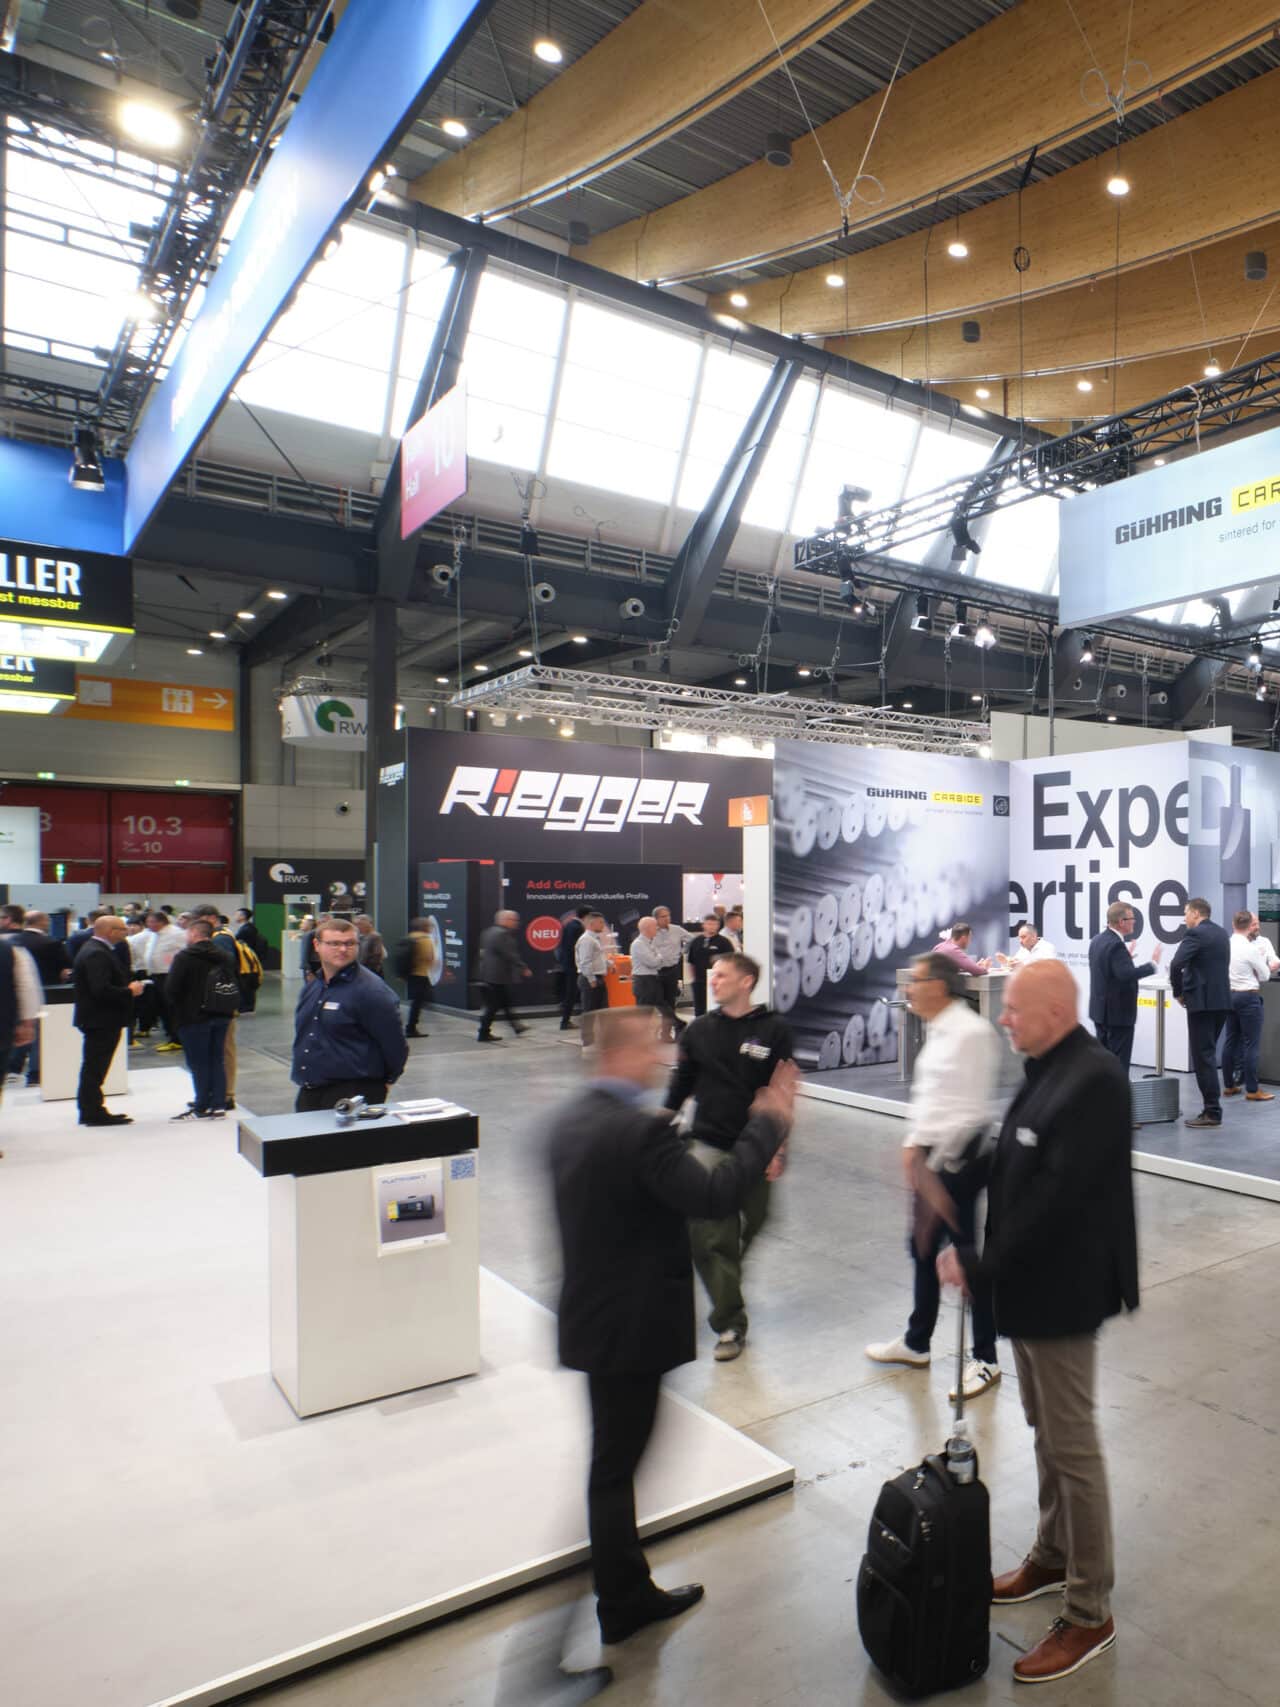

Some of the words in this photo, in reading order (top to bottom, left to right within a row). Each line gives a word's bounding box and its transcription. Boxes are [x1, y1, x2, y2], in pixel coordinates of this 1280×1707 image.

[1115, 496, 1223, 545] GÜHRING
[1218, 523, 1259, 544] sintered
[1262, 520, 1277, 534] for
[18, 594, 82, 611] messbar
[933, 792, 982, 804] CARBIDE
[122, 815, 183, 836] 10.3
[1033, 770, 1190, 868] Expe
[143, 841, 163, 854] 10
[283, 873, 309, 884] RWS
[527, 879, 551, 889] Add
[554, 879, 586, 889] Grind
[1009, 859, 1190, 945] ertise
[531, 929, 559, 939] NEU
